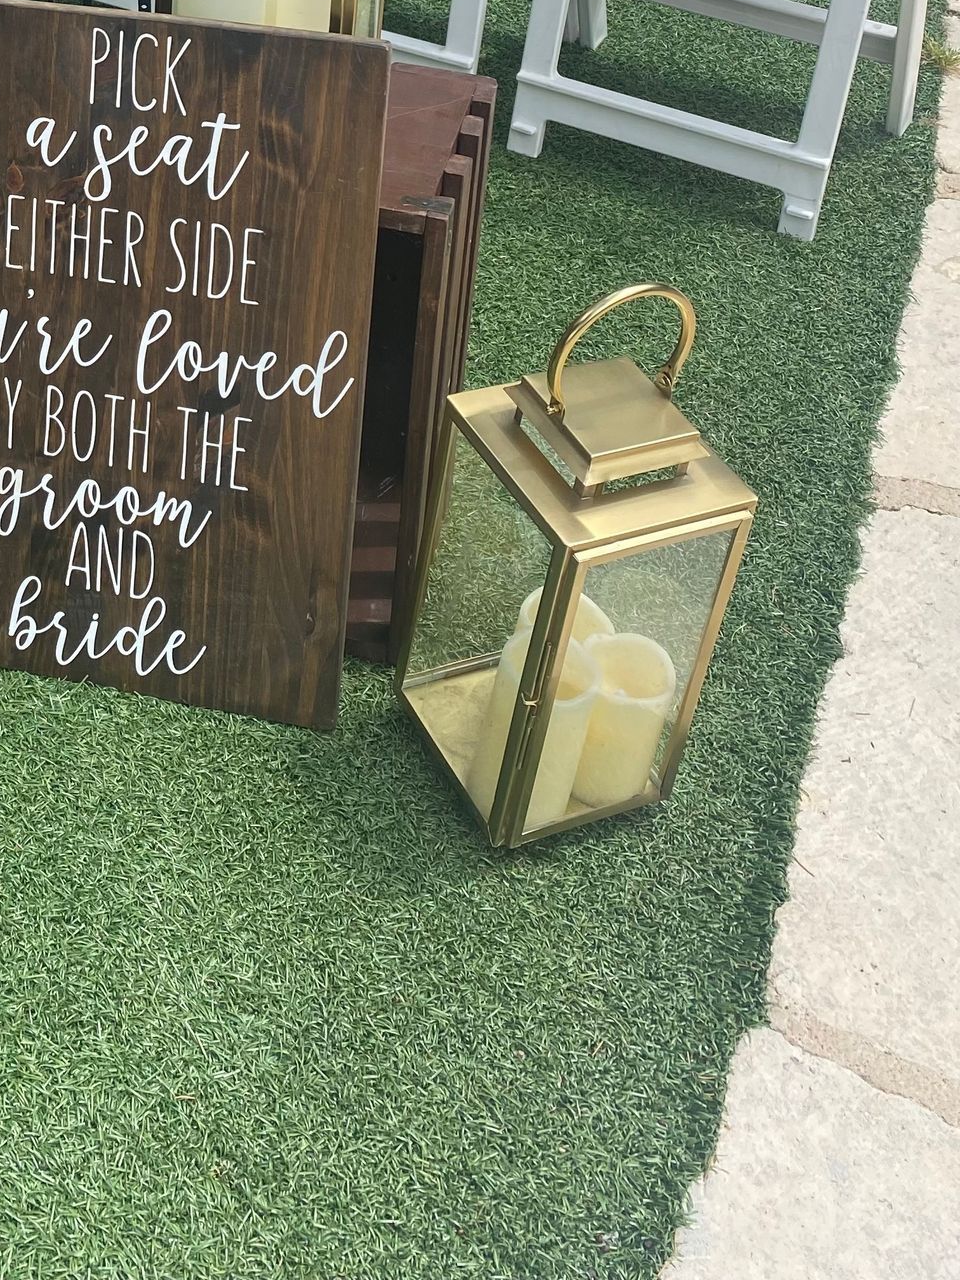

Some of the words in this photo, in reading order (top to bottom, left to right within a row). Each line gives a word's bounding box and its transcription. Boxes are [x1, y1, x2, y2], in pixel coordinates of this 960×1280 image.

[89, 27, 192, 116] PICK
[26, 116, 77, 167] a
[83, 112, 250, 201] seat
[5, 194, 145, 287] EITHER
[165, 218, 264, 306] SIDE
[137, 309, 355, 418] loved
[44, 384, 151, 473] BOTH
[176, 406, 253, 491] THE
[64, 522, 155, 600] AND
[8, 575, 207, 676] bride
